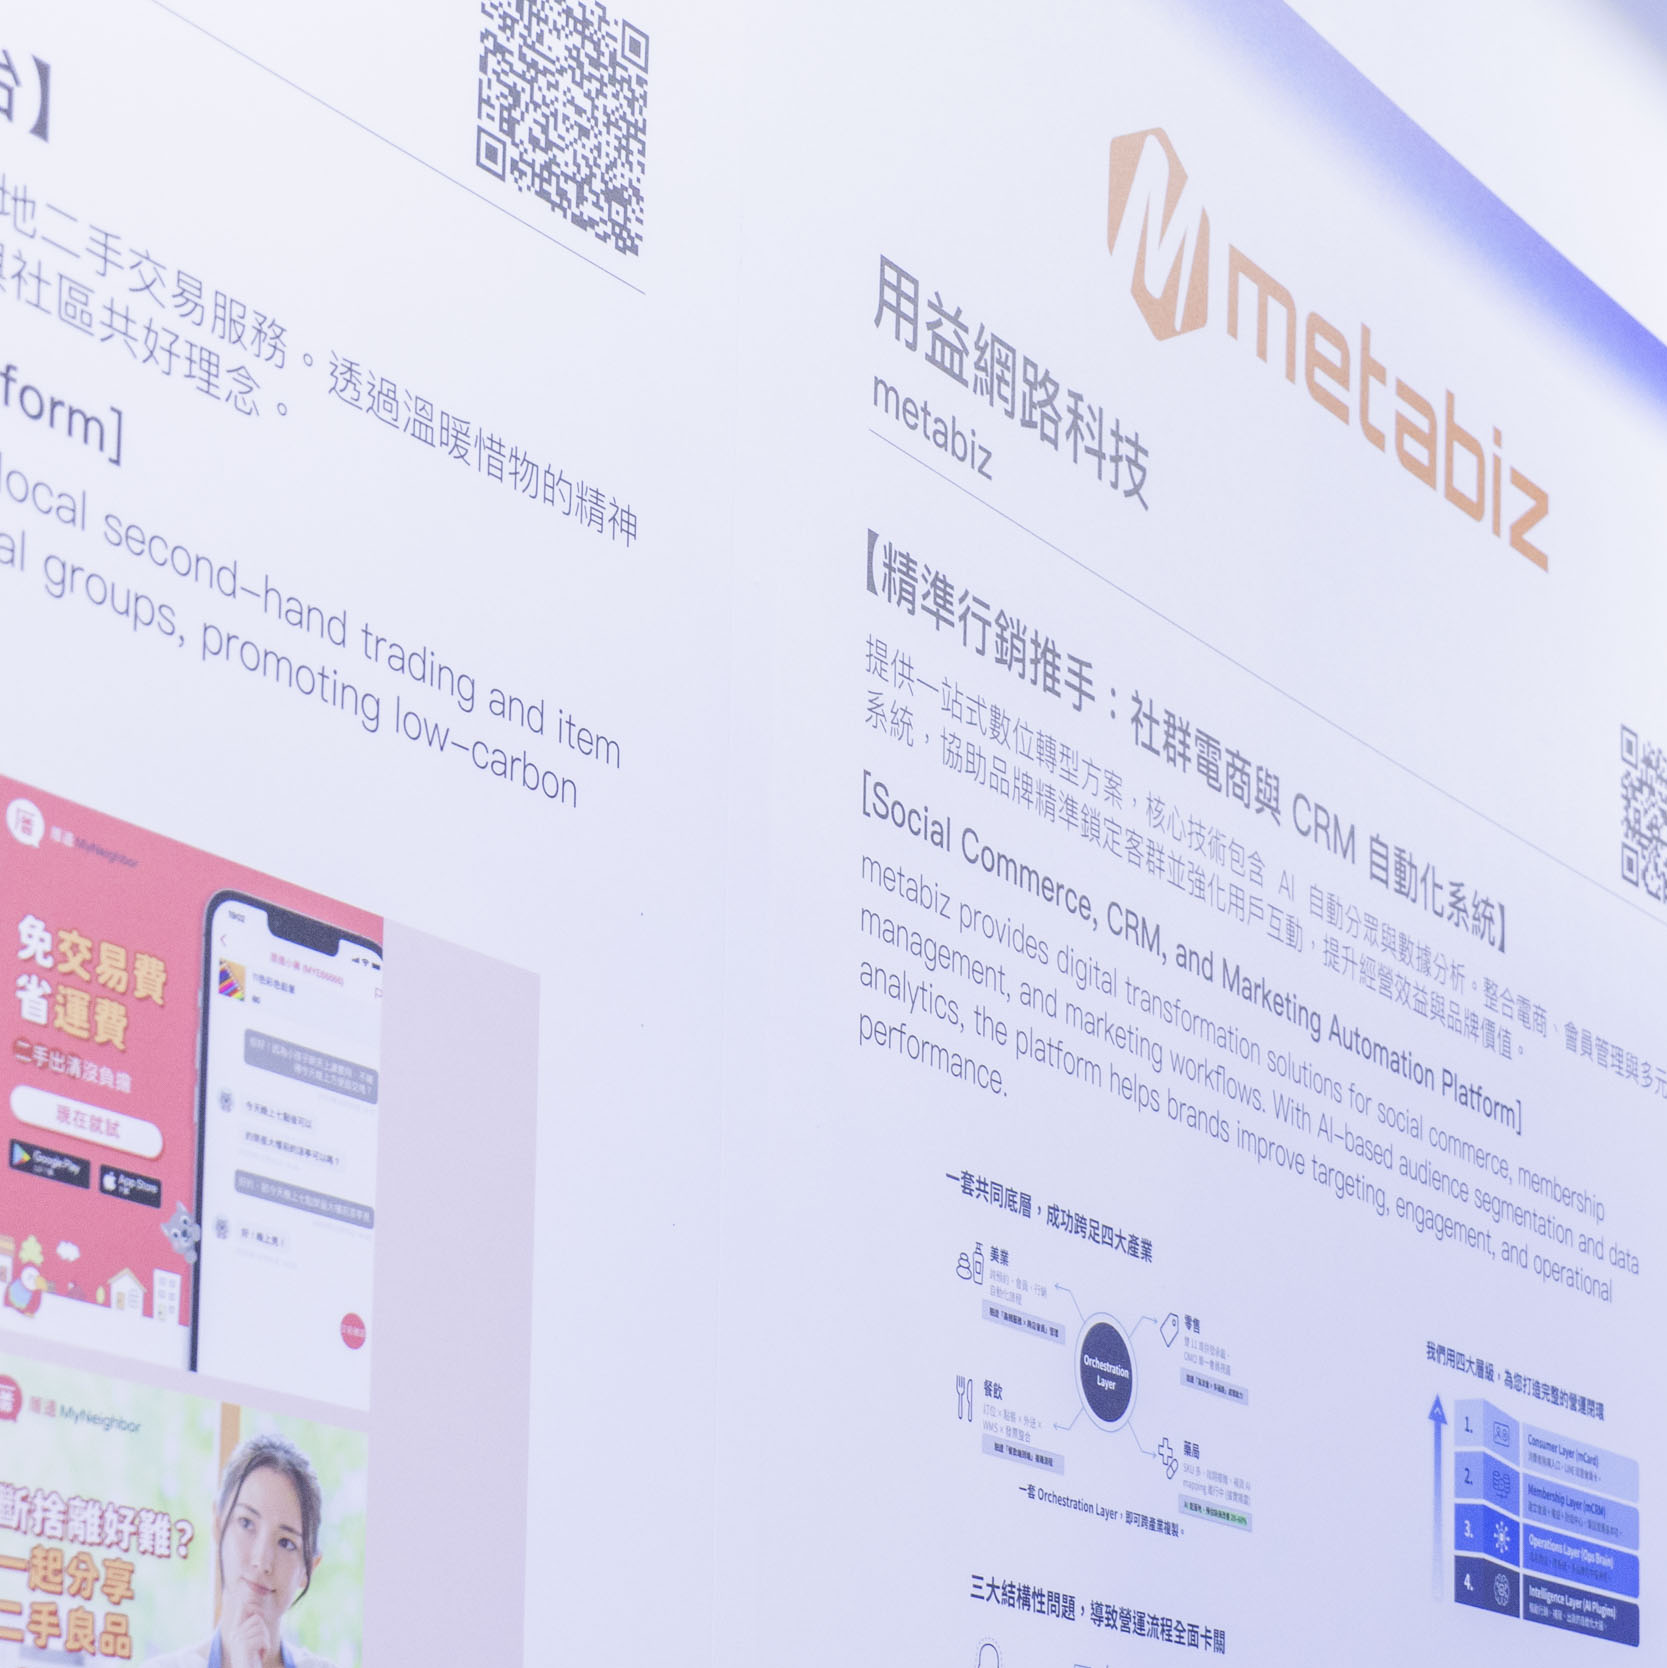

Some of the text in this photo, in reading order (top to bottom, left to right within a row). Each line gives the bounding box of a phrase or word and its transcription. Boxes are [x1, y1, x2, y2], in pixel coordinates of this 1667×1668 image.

[0, 175, 637, 547] 地二手交易服務。透過溫暖惜物的精神
[872, 375, 994, 482] metabiz
[873, 253, 1150, 512] 用益網路科技
[1227, 243, 1550, 575] metabiz
[0, 452, 620, 769] local second-hand trading and item
[44, 555, 185, 648] groups,
[202, 623, 380, 734] promoting
[396, 696, 577, 809] low-carbon
[17, 914, 168, 1008] 免交易費
[863, 770, 1521, 1136] [Social Commerce, CRM, and Marketing Automation Platform]
[1278, 870, 1294, 901] AI
[1293, 793, 1355, 865] CRM
[1370, 834, 1505, 953] 自動化系統】
[15, 973, 130, 1052] 省運費
[860, 1013, 1007, 1097] performance.
[861, 908, 1639, 1275] management, and marketing workflows. With AI-based audience segmentation and data
[862, 855, 1604, 1224] metabiz provides digital transformation solutions for social commerce, membership
[860, 962, 1612, 1303] analytics, the platform helps brands improve targeting, engagement, and operational
[946, 1173, 1152, 1263] 一套共同底層，成功跨足四大產業
[0, 1543, 136, 1603] 一起分享
[970, 1575, 1225, 1655] 三大結構性問題，導致營運流程全面卡關
